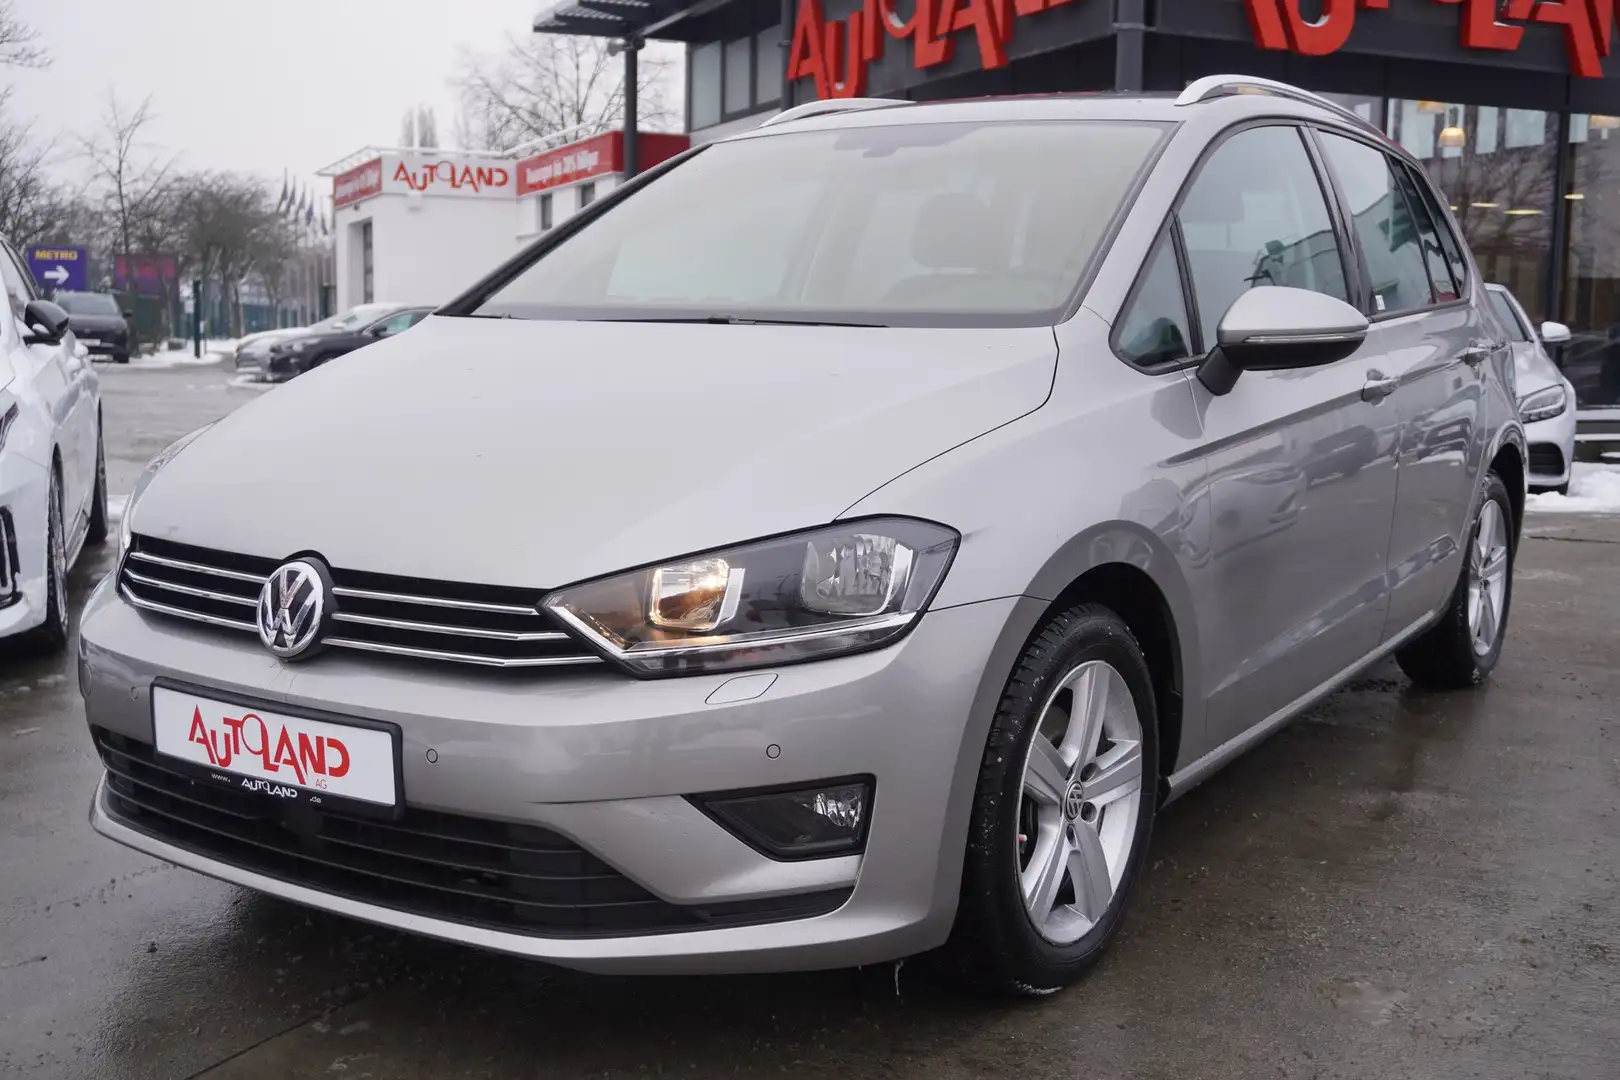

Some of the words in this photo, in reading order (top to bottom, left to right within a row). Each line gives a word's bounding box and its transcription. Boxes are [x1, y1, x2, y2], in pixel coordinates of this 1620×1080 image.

[393, 160, 508, 193] AUTOLAND
[35, 249, 78, 261] METRO
[188, 704, 350, 785] AUTOLAND
[211, 773, 231, 783] www.
[241, 778, 298, 798] AUTOLAND
[315, 779, 328, 790] AG
